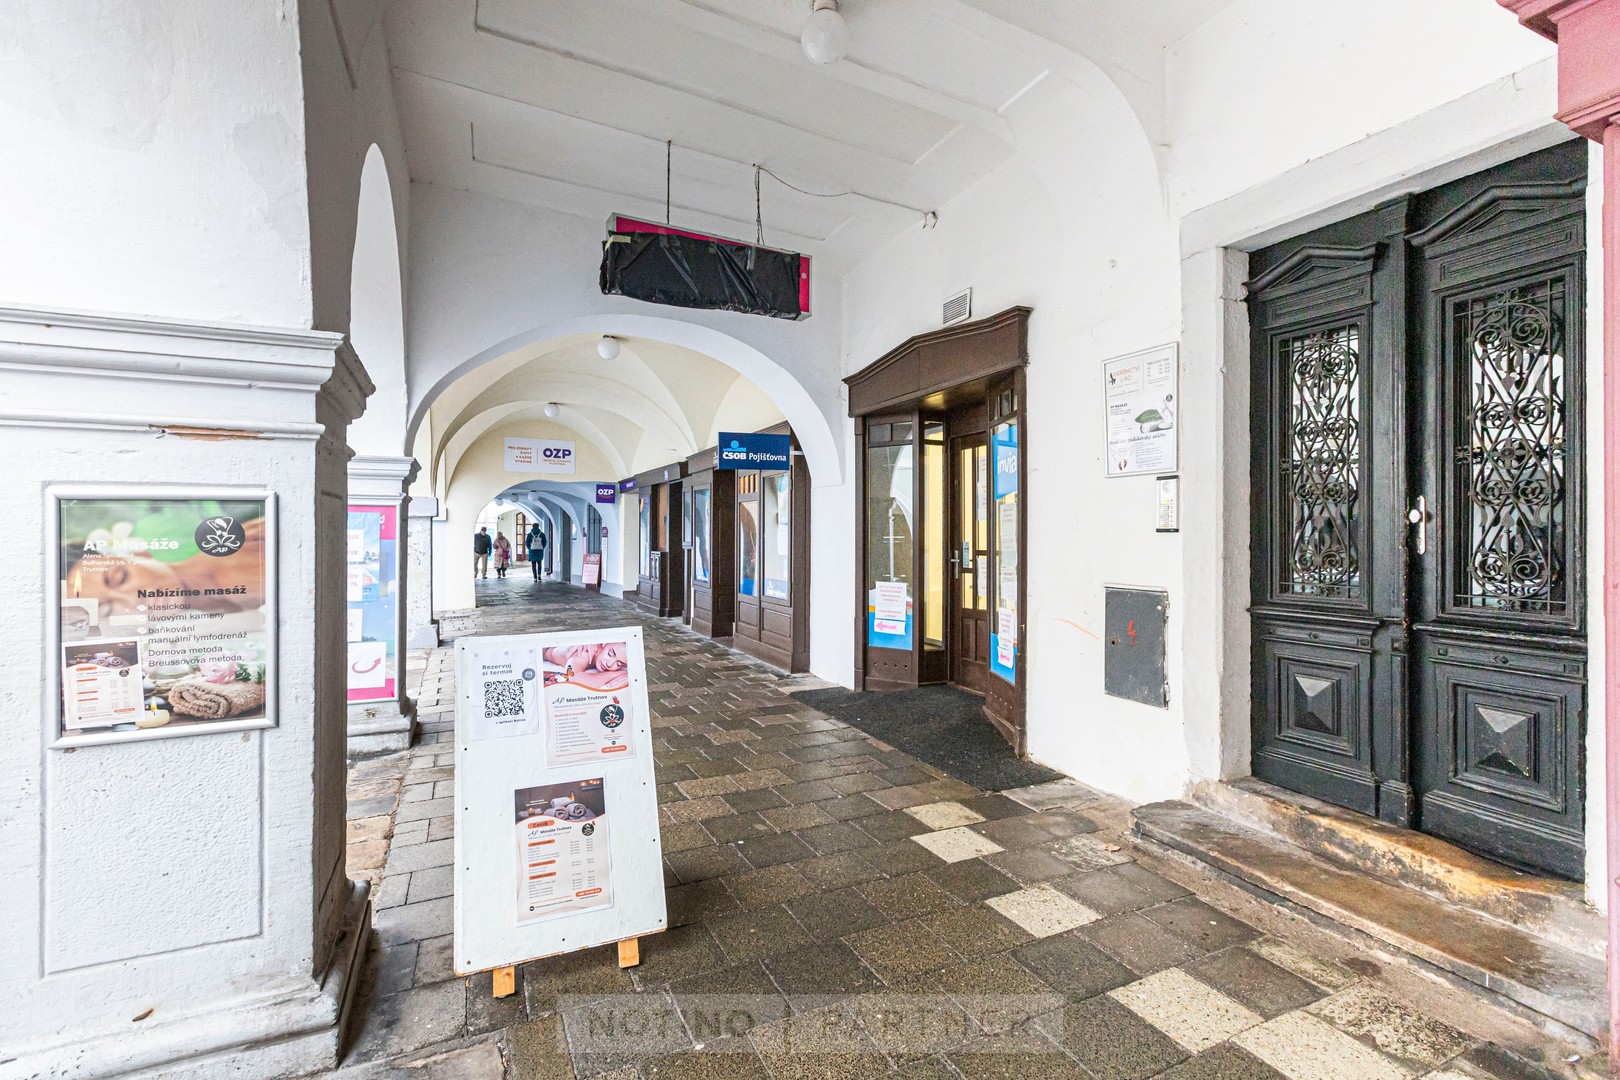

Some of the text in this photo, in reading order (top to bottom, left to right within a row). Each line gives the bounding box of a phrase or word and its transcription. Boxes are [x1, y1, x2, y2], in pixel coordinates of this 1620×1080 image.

[543, 448, 572, 459] OZP
[722, 452, 746, 460] ČSOB
[748, 452, 786, 462] Pojišťovna
[998, 452, 1016, 475] invia
[83, 538, 179, 551] AP Masáže
[137, 585, 246, 598] Nabízíme masáž
[148, 614, 187, 622] lávovými
[148, 625, 195, 634] baňkování
[148, 632, 248, 644] manuální lymfodrenáž
[148, 658, 206, 667] Breussovova
